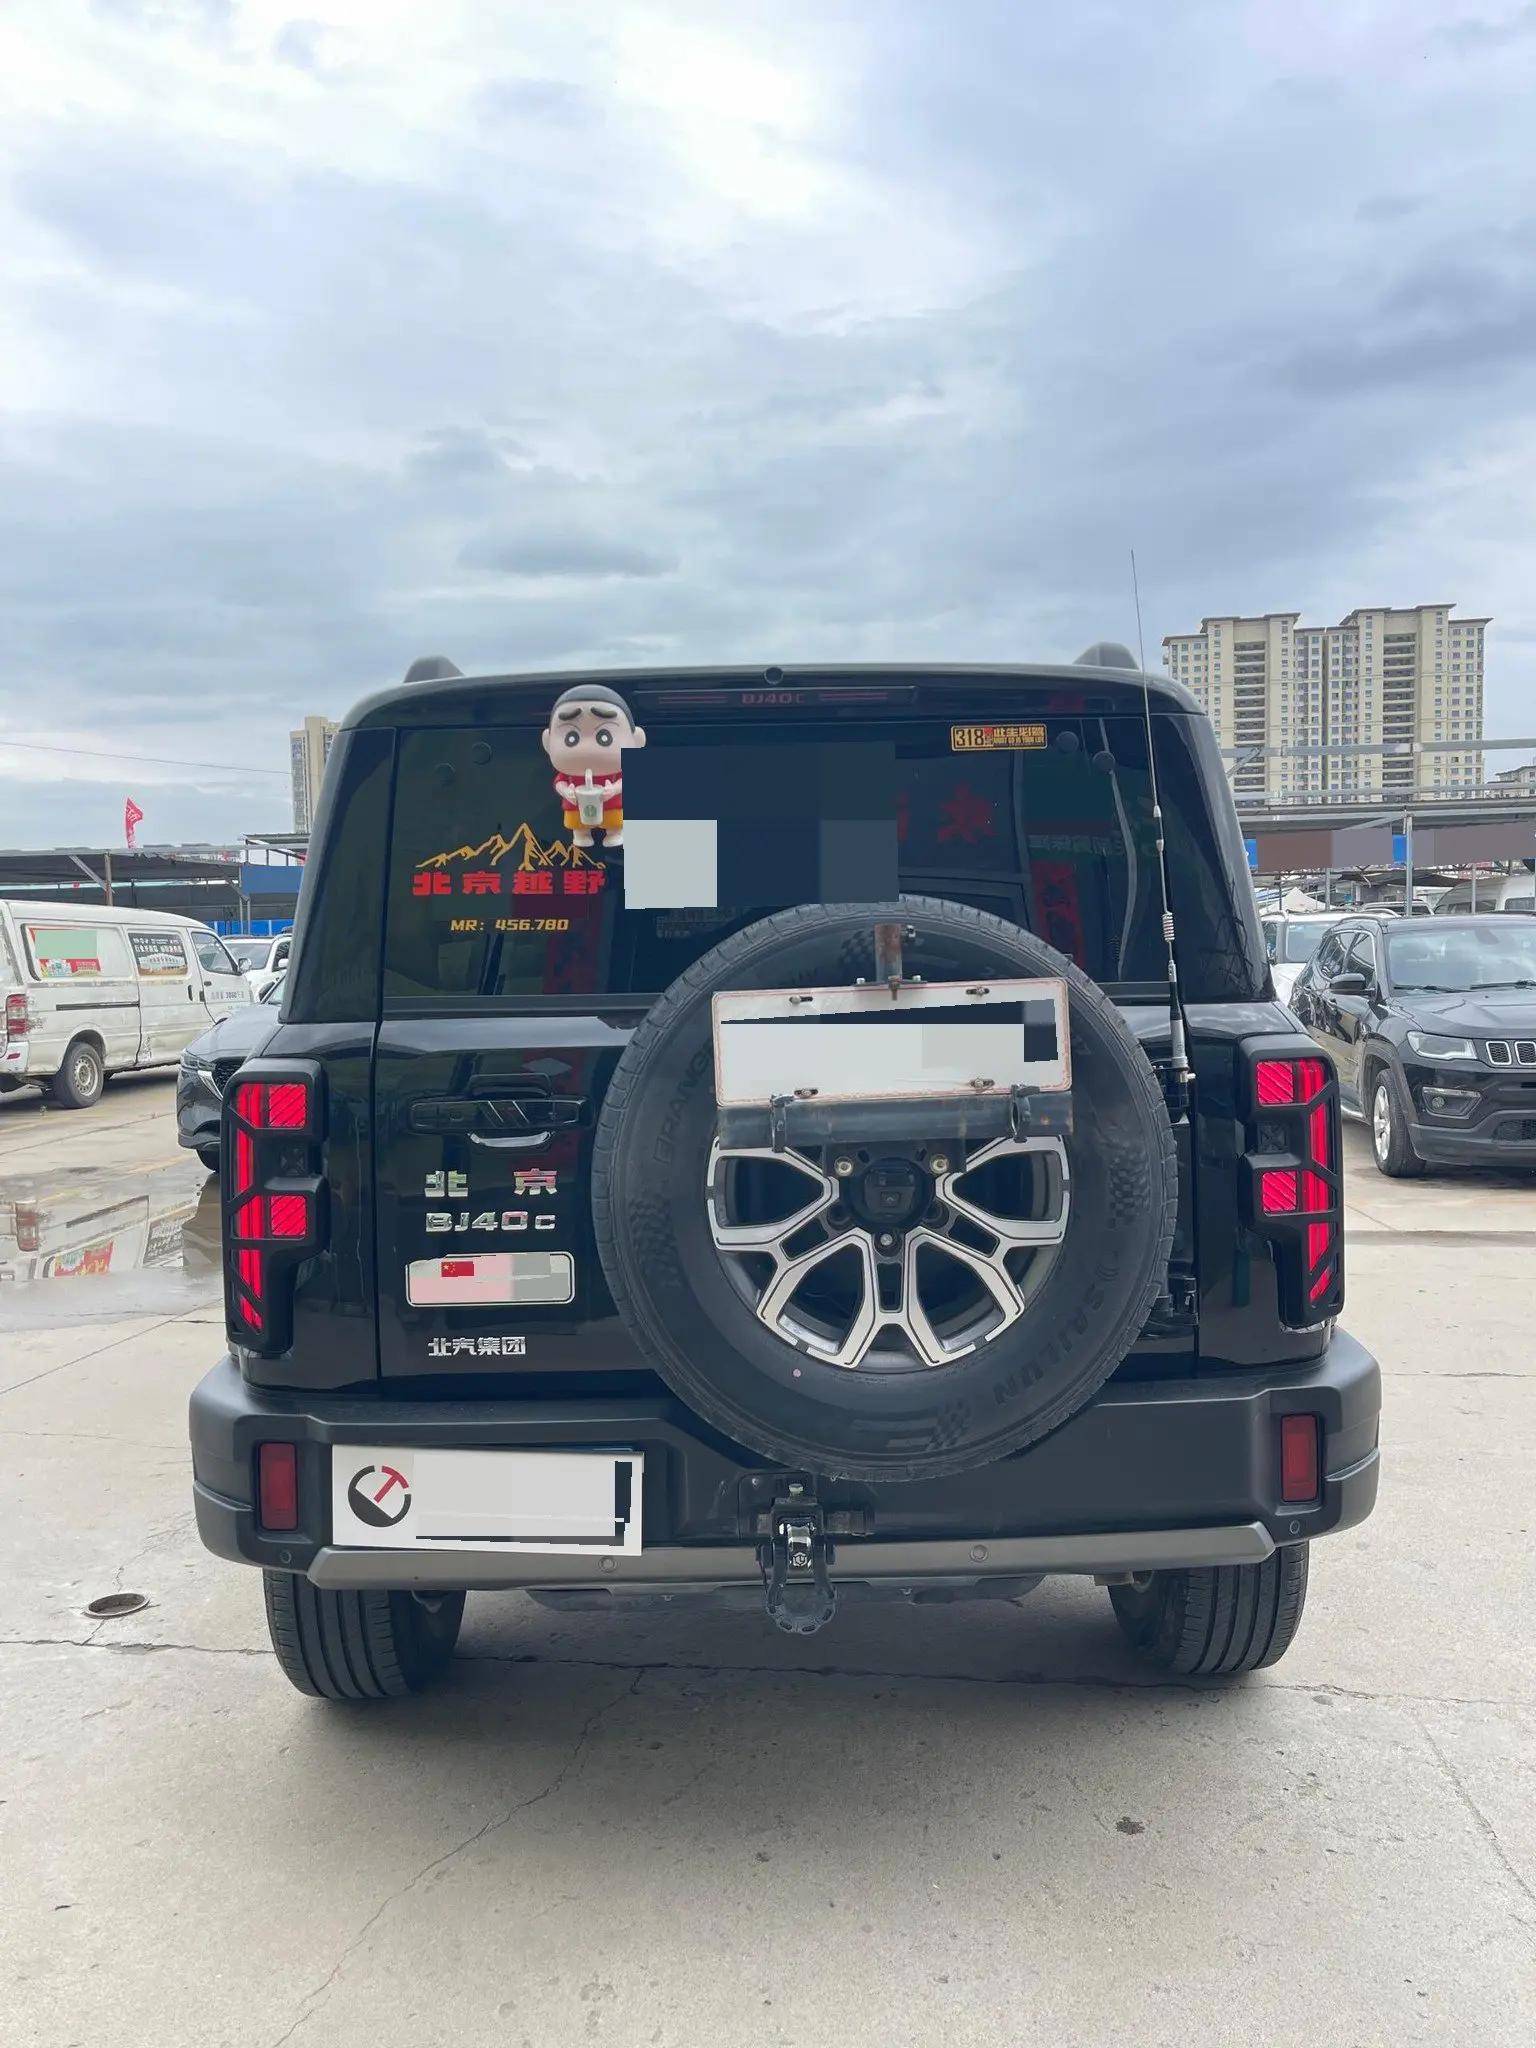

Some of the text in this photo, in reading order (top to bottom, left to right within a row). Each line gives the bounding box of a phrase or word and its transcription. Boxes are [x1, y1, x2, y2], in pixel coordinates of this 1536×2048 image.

[955, 728, 984, 746] 318
[412, 871, 606, 896] 北京越野
[495, 919, 569, 931] 456.780
[424, 1168, 558, 1198] 北京
[428, 1336, 527, 1357] 北汽集团
